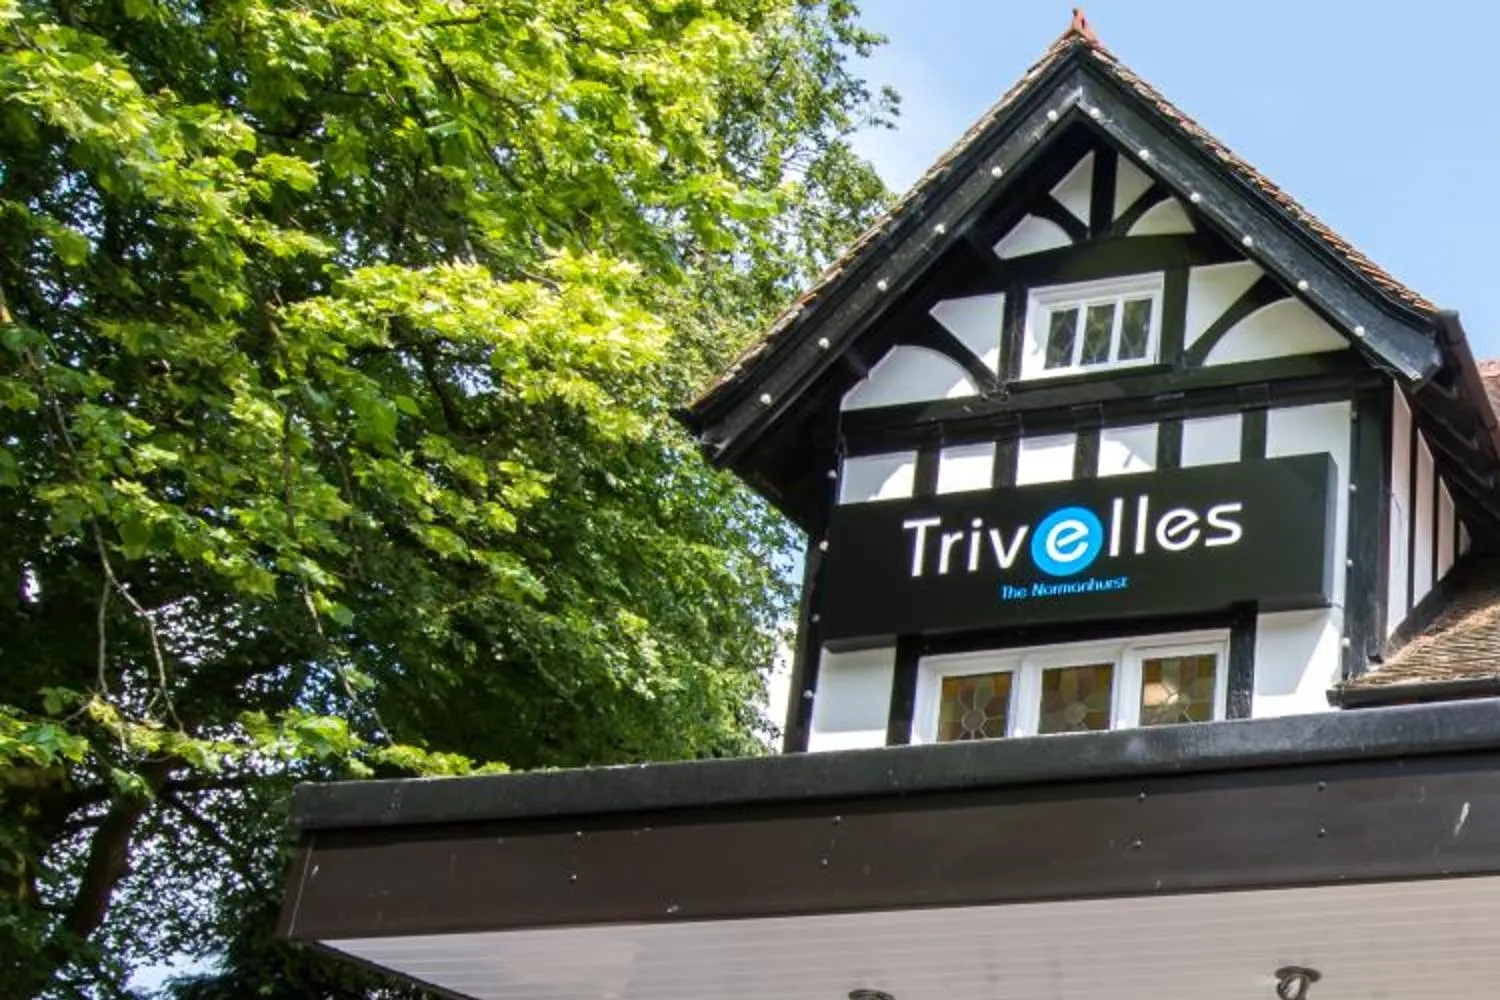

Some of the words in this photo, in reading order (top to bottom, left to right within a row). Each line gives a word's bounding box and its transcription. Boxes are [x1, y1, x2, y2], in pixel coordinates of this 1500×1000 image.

[902, 494, 1244, 578] Trivelles
[1002, 584, 1027, 601] The
[1031, 576, 1129, 597] Normanhurst
